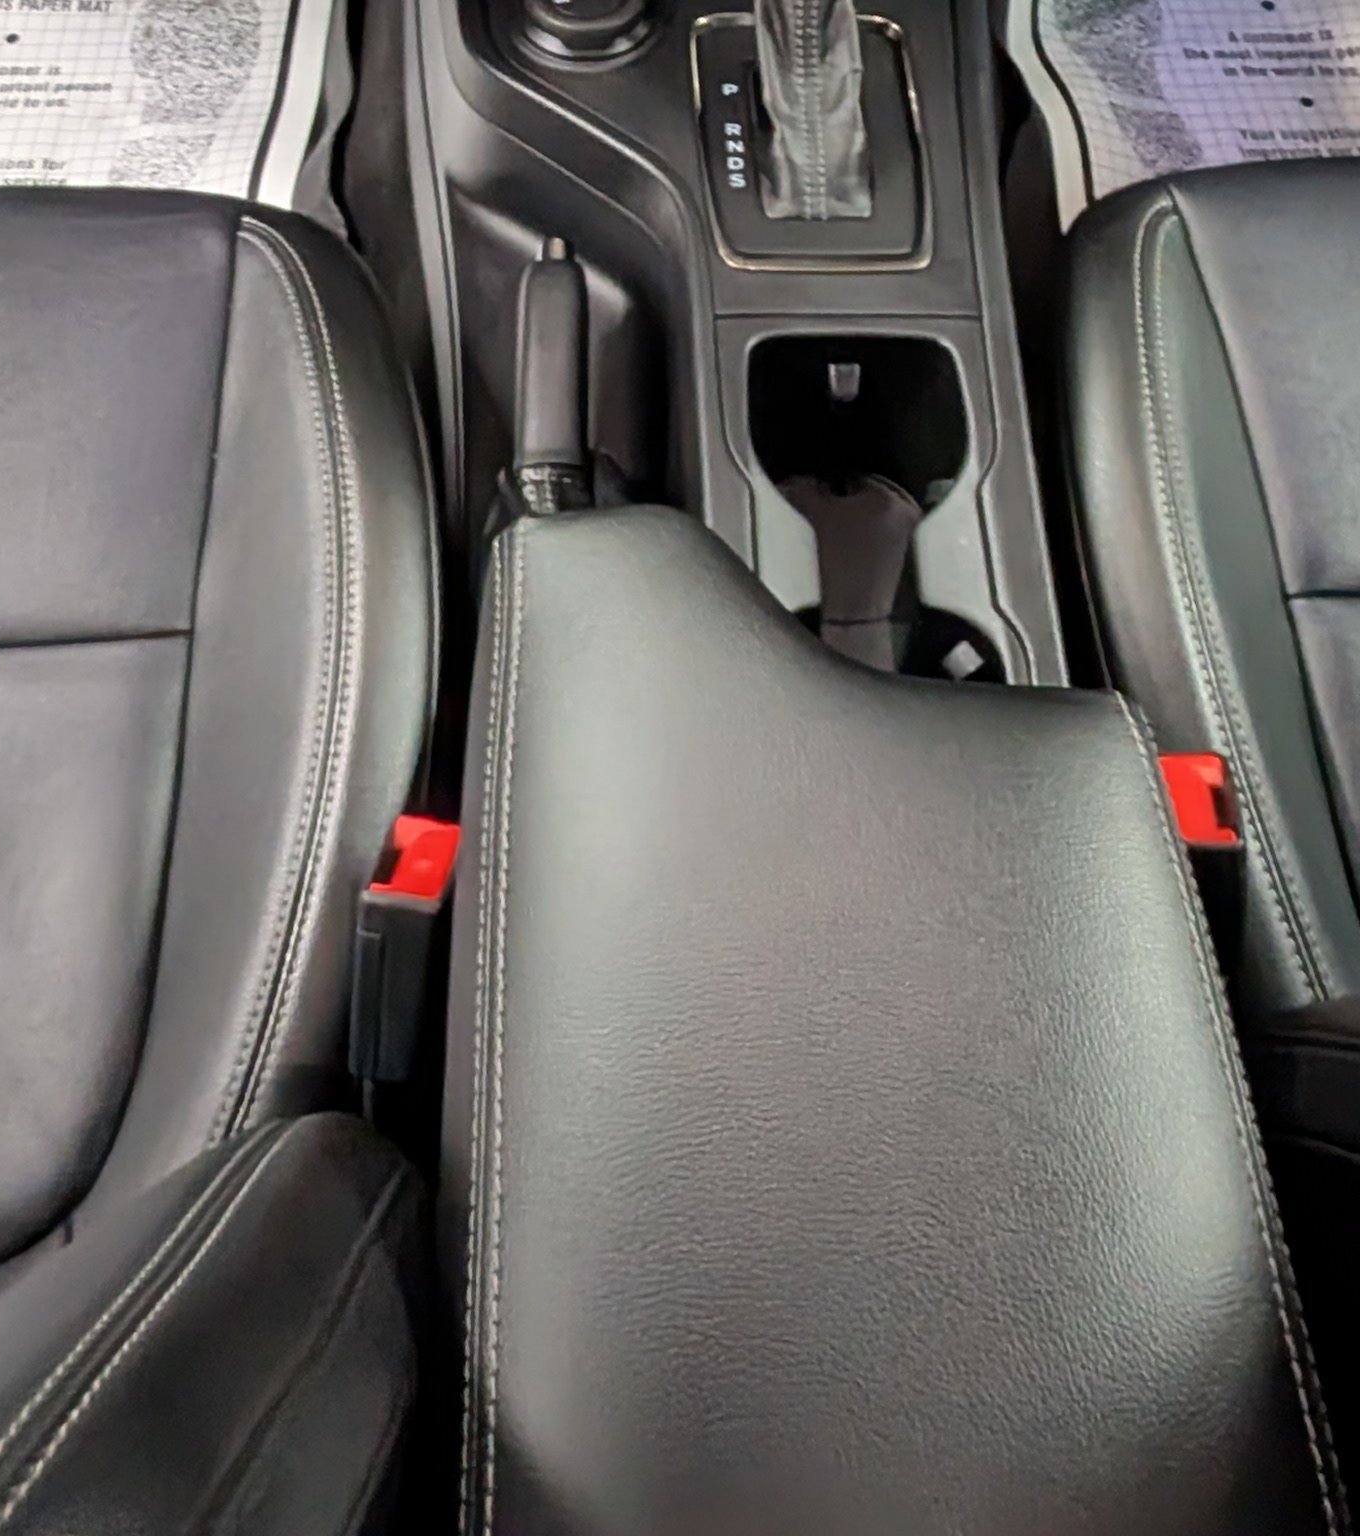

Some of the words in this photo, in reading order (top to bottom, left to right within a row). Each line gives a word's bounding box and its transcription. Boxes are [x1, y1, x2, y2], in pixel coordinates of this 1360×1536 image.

[77, 0, 114, 13] MAT
[721, 83, 739, 96] P
[724, 122, 742, 136] R
